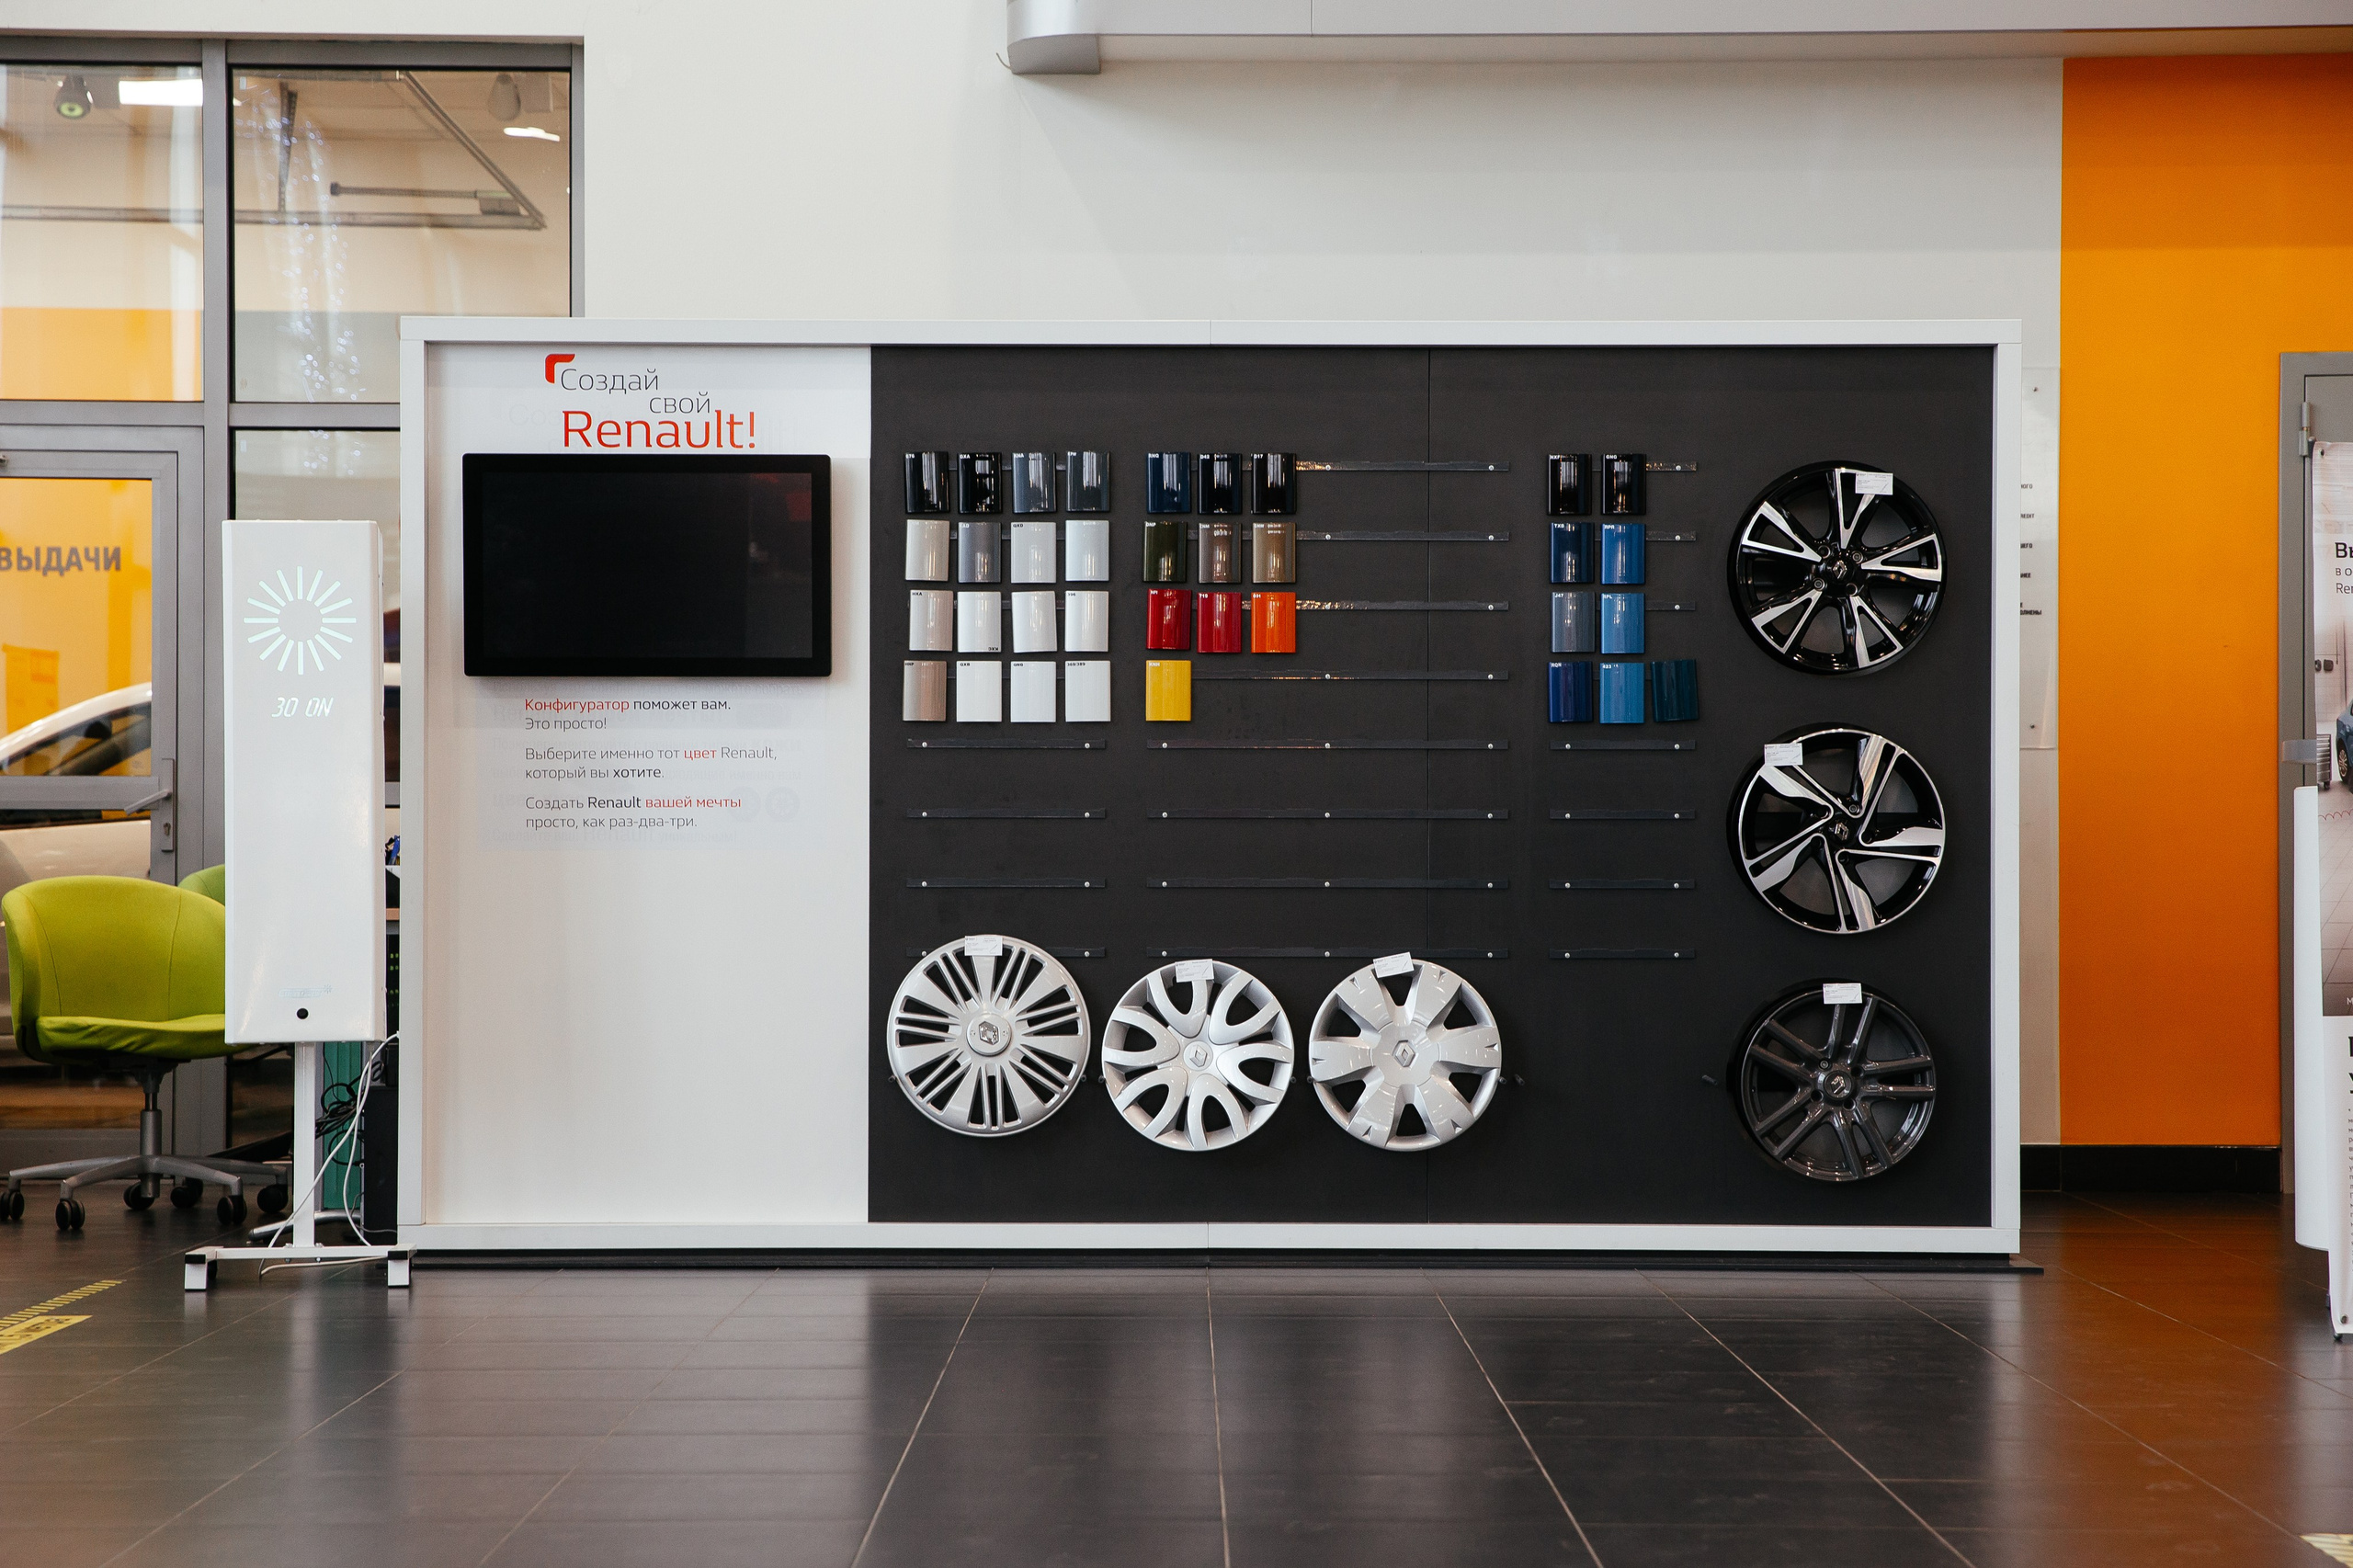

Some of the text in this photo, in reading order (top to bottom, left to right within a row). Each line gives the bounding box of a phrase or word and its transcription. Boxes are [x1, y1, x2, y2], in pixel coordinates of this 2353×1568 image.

[562, 369, 657, 394] Создай
[650, 392, 710, 414] свой
[563, 409, 755, 449] Renault!
[0, 546, 121, 577] ВЫДАЧИ
[271, 697, 335, 718] 30 ON
[525, 698, 630, 714] Конфигуратор
[633, 700, 698, 710] поможет
[700, 700, 731, 710] вам.
[525, 717, 607, 733] Это просто!
[525, 745, 777, 763] Выберите именно тот цвет Renault,
[525, 766, 586, 782] который
[590, 768, 609, 778] вы
[613, 768, 665, 778] хотите.
[525, 796, 585, 812] Создать
[587, 795, 642, 809] Renault
[645, 795, 692, 809] вашей
[696, 799, 741, 808] мечты
[526, 817, 698, 832] просто, как раз-два-три.
